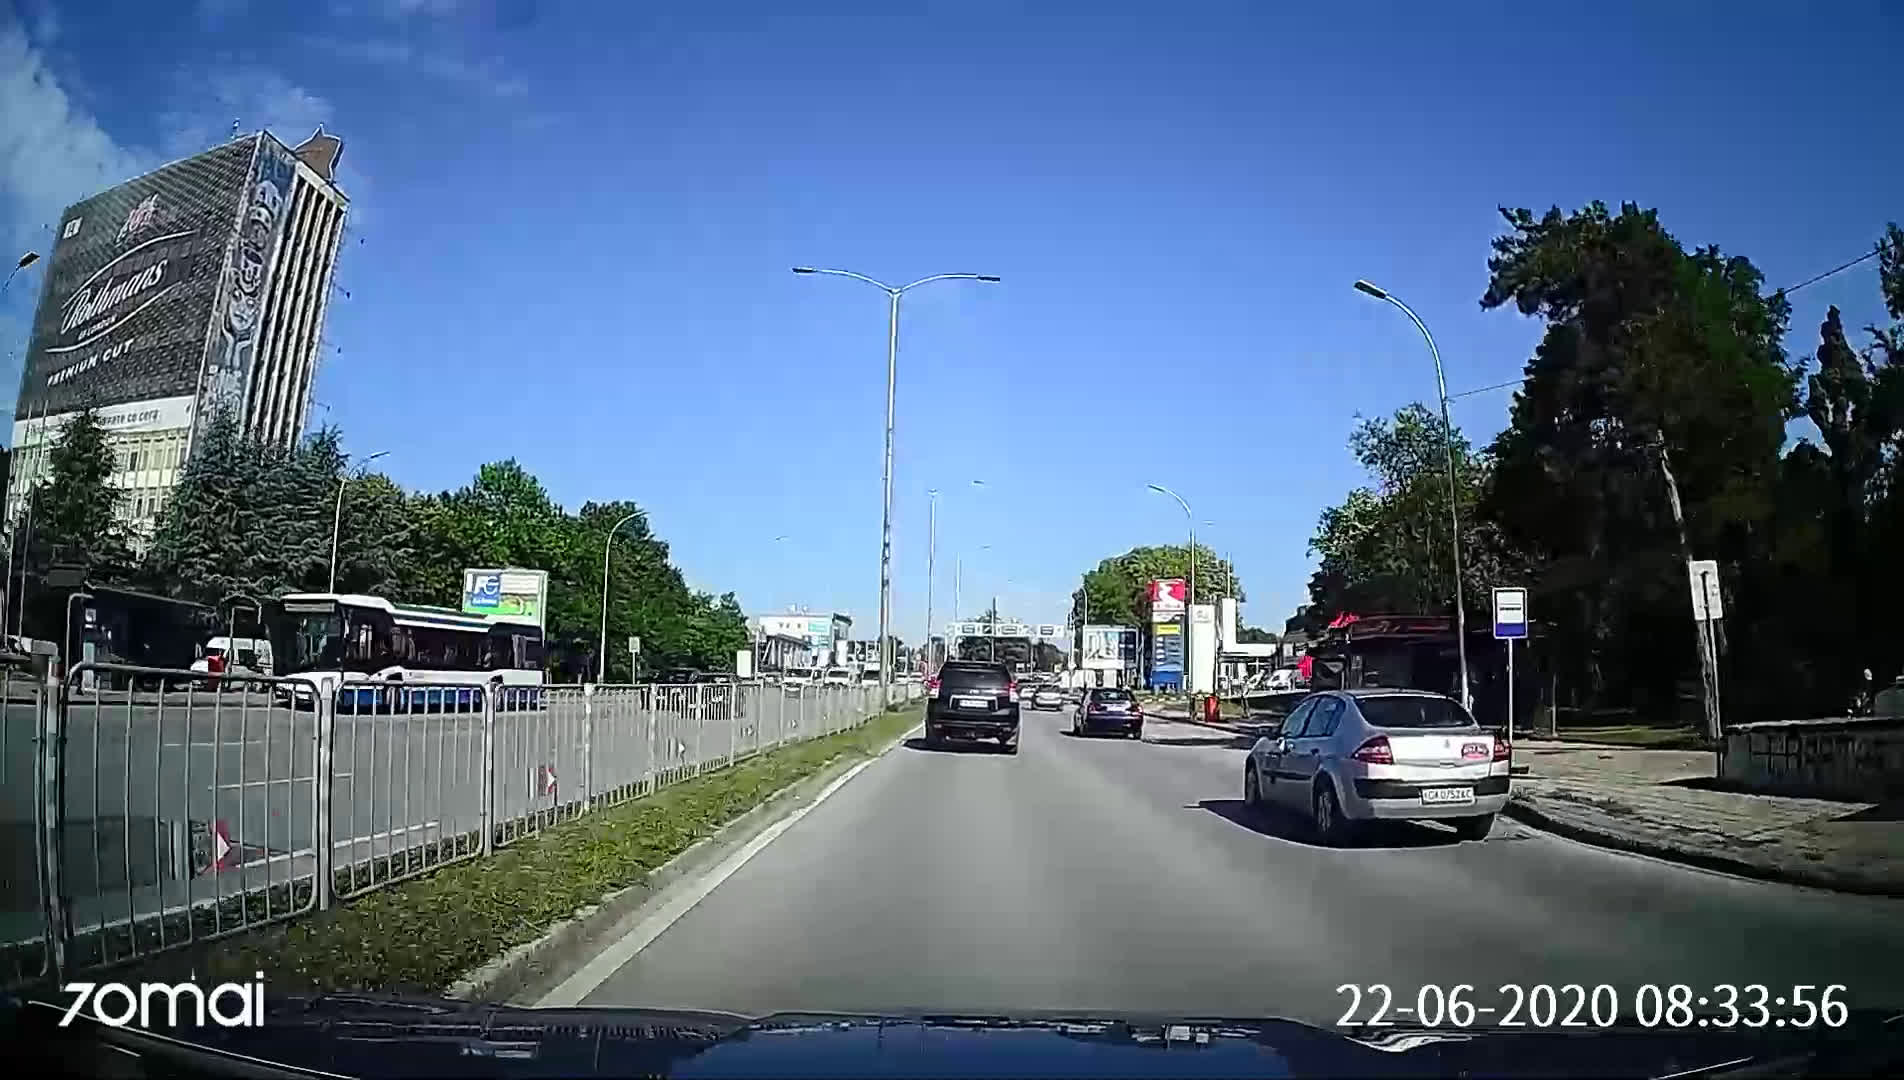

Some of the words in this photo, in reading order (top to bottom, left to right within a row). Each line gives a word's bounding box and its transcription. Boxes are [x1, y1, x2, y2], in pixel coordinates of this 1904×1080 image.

[61, 259, 168, 335] Rothmans
[47, 354, 98, 387] PREMIUM
[102, 339, 135, 361] CUT
